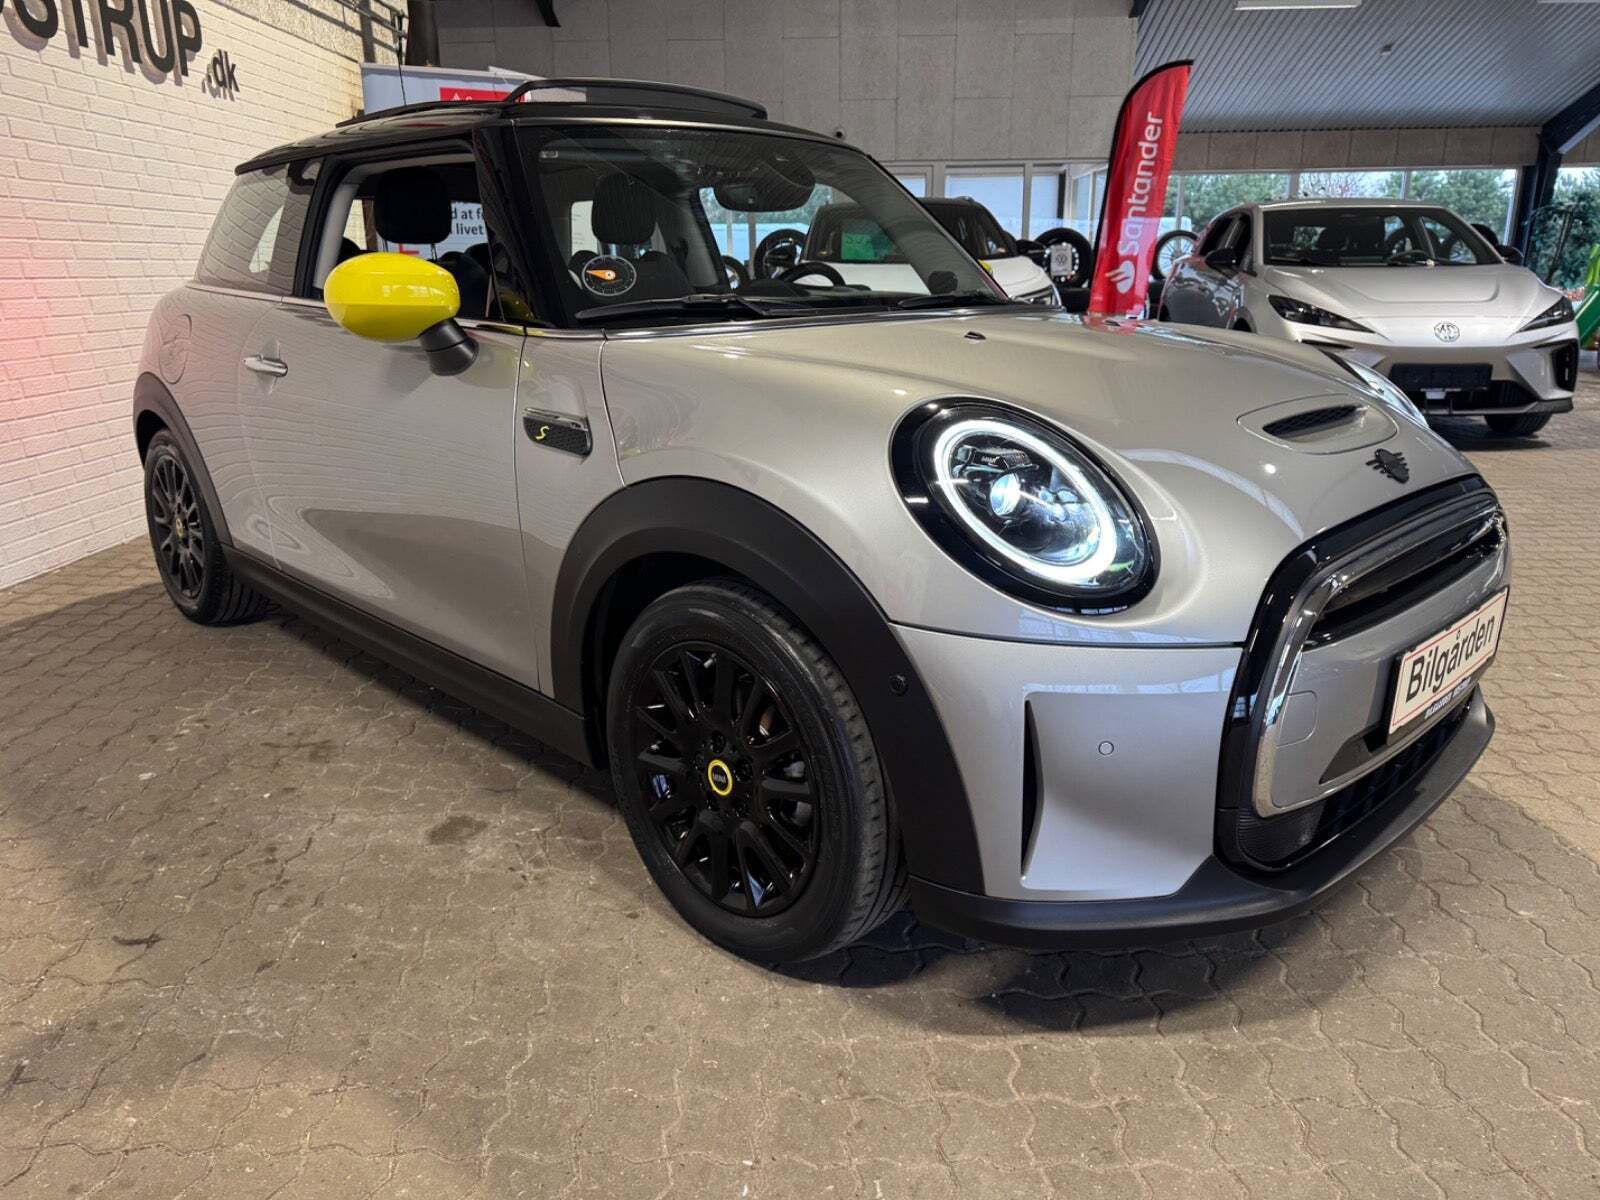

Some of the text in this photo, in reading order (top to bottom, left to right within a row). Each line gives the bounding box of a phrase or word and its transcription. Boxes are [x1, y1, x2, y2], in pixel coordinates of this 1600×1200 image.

[0, 0, 202, 77] TRUP
[461, 209, 474, 220] at
[1116, 111, 1163, 257] Santander
[456, 223, 484, 236] livet
[1406, 616, 1496, 703] Bilgården
